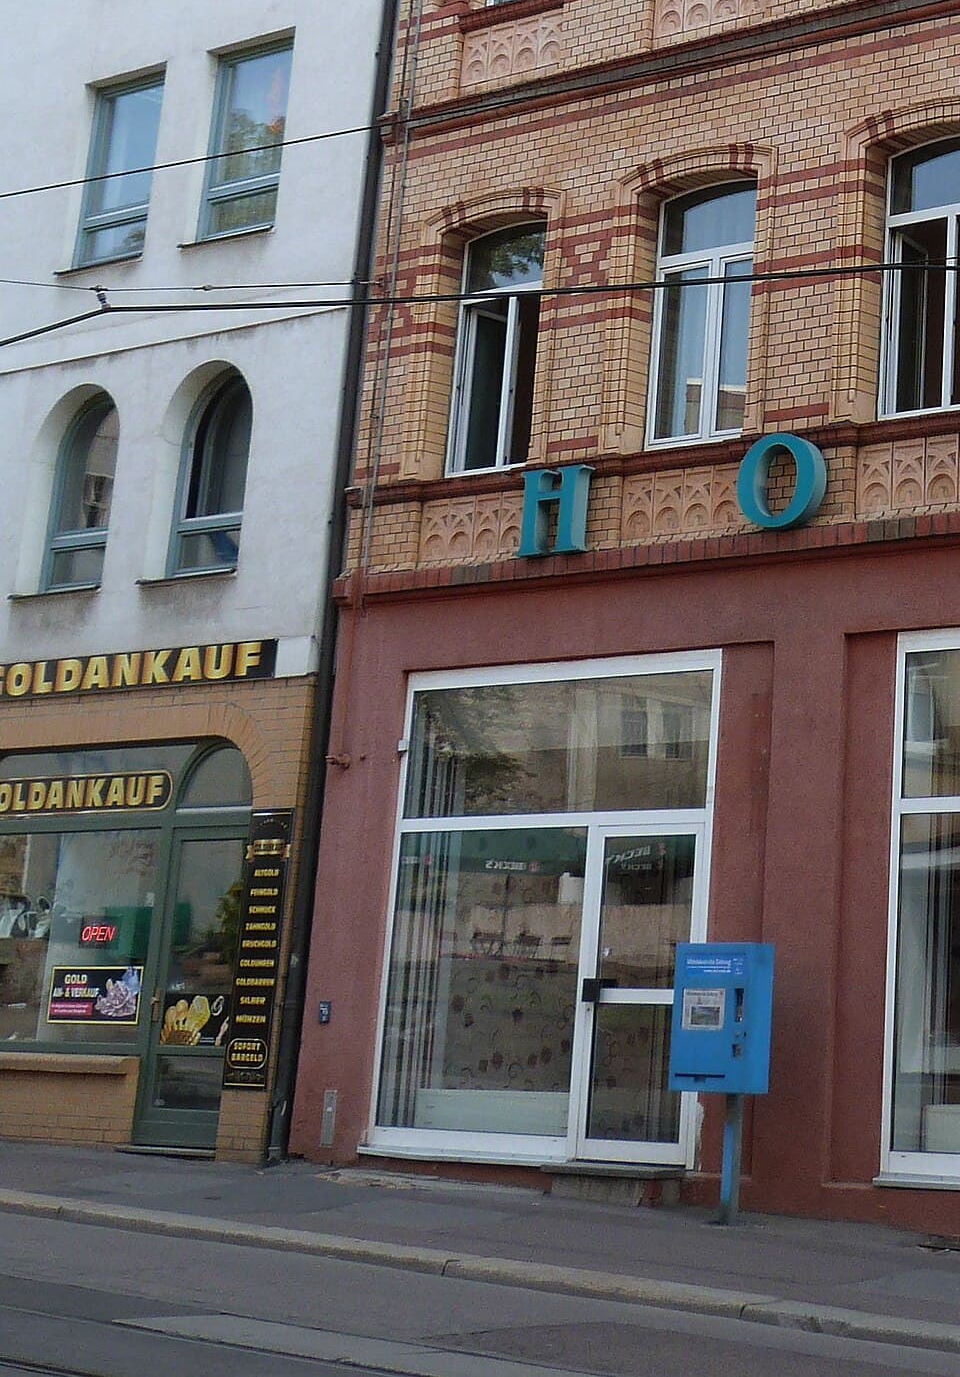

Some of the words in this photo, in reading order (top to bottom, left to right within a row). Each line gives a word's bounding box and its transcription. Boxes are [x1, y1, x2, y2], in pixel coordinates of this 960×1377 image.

[0, 641, 262, 698] OLDANKAUF
[81, 925, 116, 941] OPEN
[64, 974, 88, 985] GOLD
